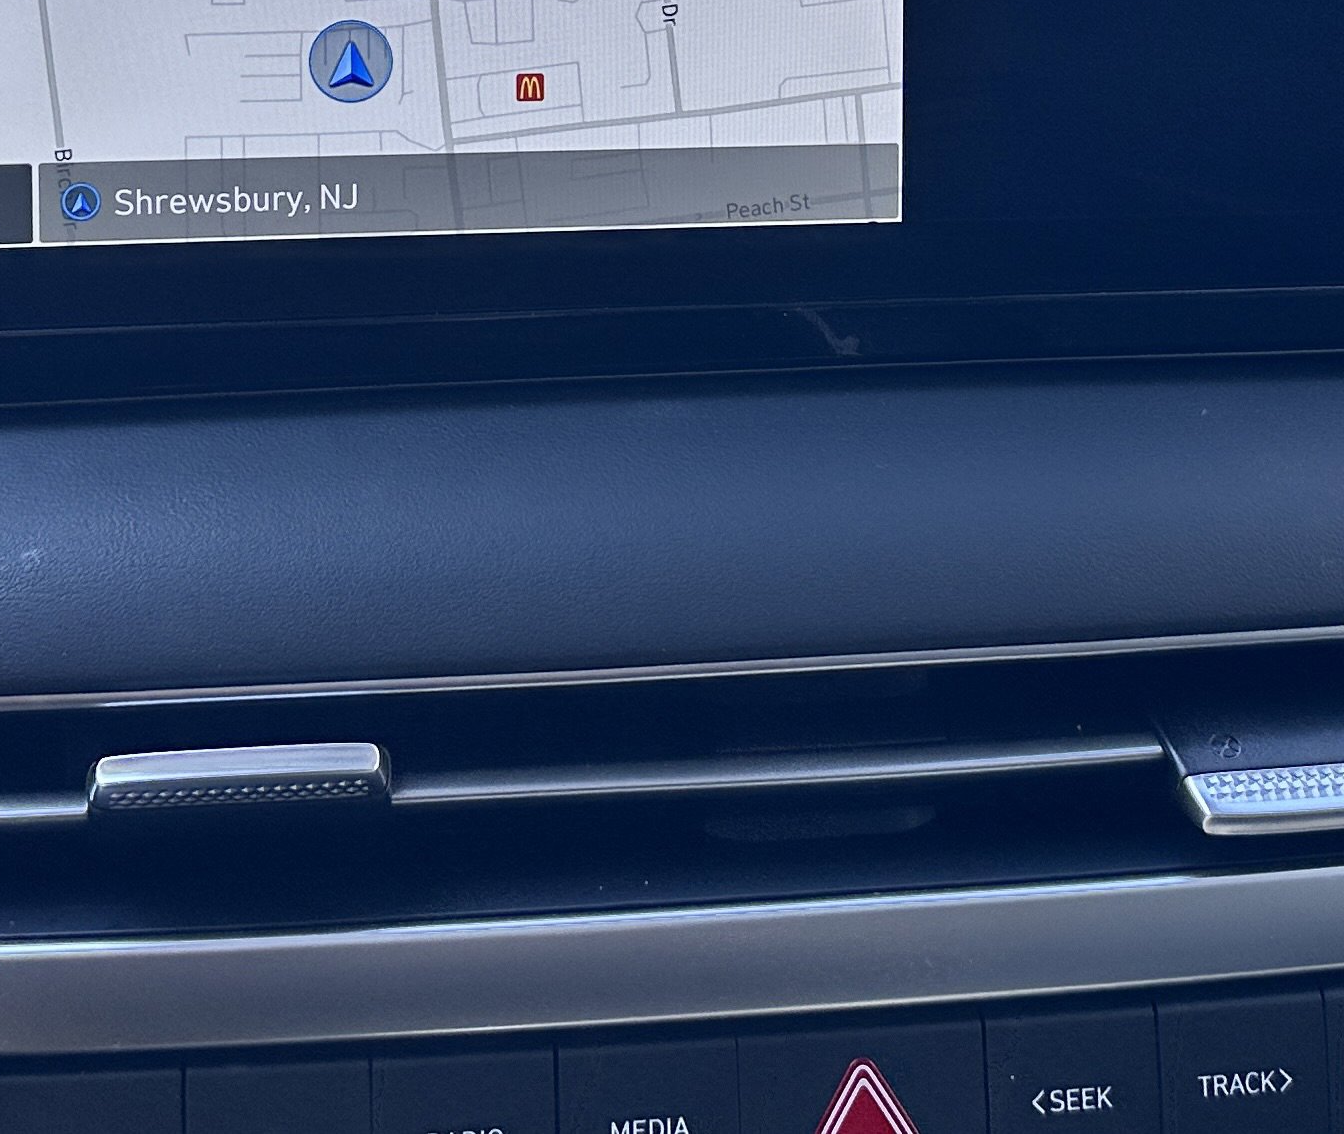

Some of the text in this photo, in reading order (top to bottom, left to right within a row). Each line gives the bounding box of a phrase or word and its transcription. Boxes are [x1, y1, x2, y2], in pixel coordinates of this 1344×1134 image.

[661, 2, 678, 26] Dr
[114, 183, 358, 218] Shrewsbury, NJ
[726, 194, 812, 219] Peach St
[1197, 1070, 1277, 1098] TRACK
[1050, 1086, 1113, 1113] SEEK
[611, 1116, 690, 1134] MEDIA
